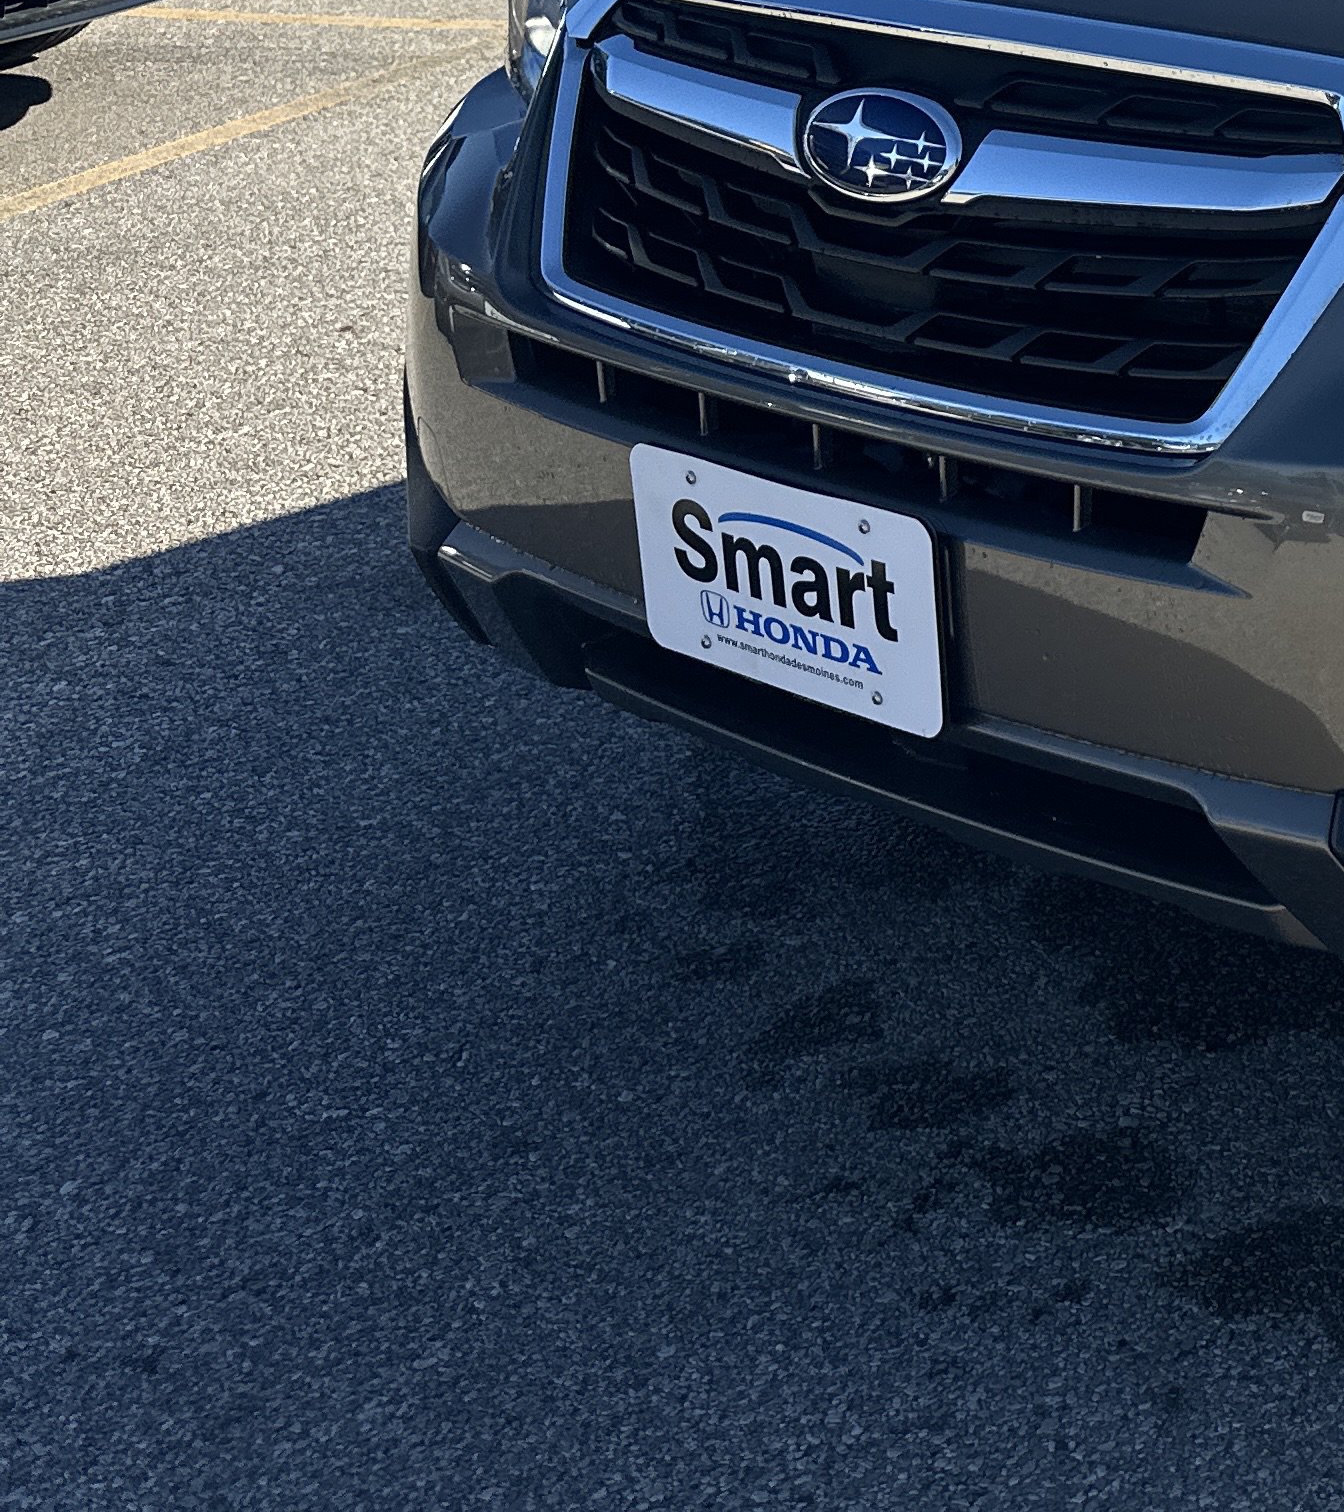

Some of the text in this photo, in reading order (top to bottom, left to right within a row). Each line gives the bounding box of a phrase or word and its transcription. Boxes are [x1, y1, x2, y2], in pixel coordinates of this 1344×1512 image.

[671, 498, 899, 643] Smart
[716, 633, 865, 691] www.smarthondadesmoines.com
[732, 604, 883, 676] HONDA
